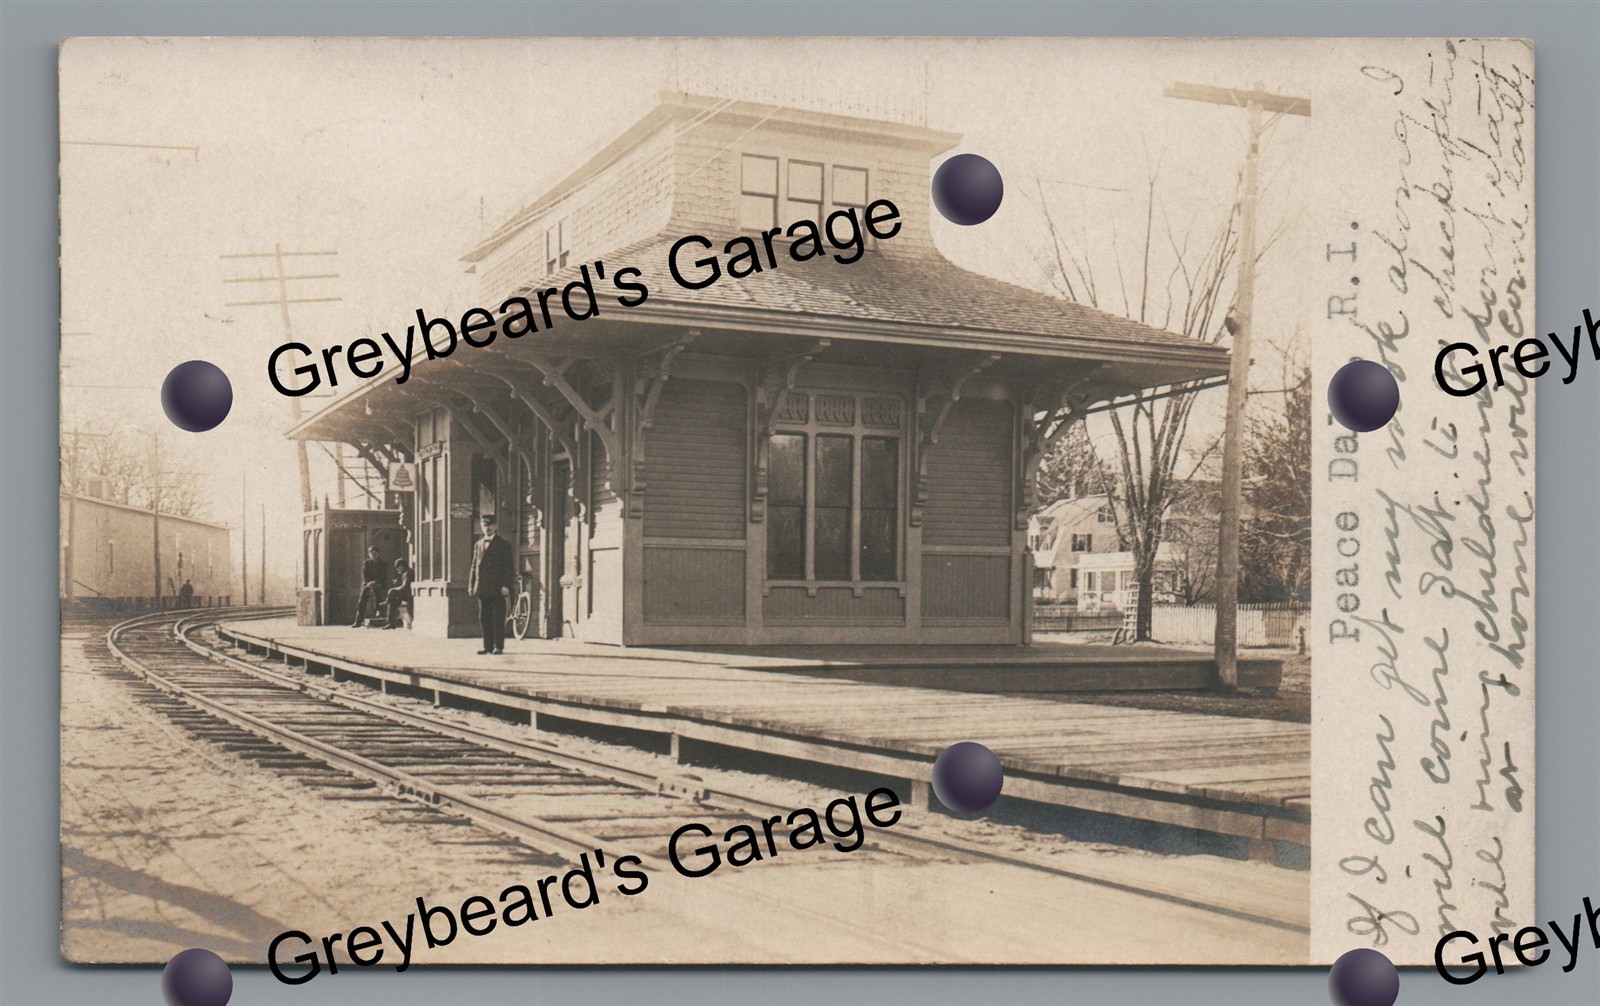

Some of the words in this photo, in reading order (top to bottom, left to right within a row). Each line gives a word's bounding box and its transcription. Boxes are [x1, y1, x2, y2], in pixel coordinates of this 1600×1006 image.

[1327, 222, 1360, 319] R.I.
[1329, 511, 1360, 644] Peace
[1488, 491, 1534, 670] home
[1350, 608, 1430, 706] get
[1420, 627, 1451, 784] come
[1364, 714, 1395, 844] can
[1338, 856, 1387, 884] I
[1406, 816, 1457, 944] will
